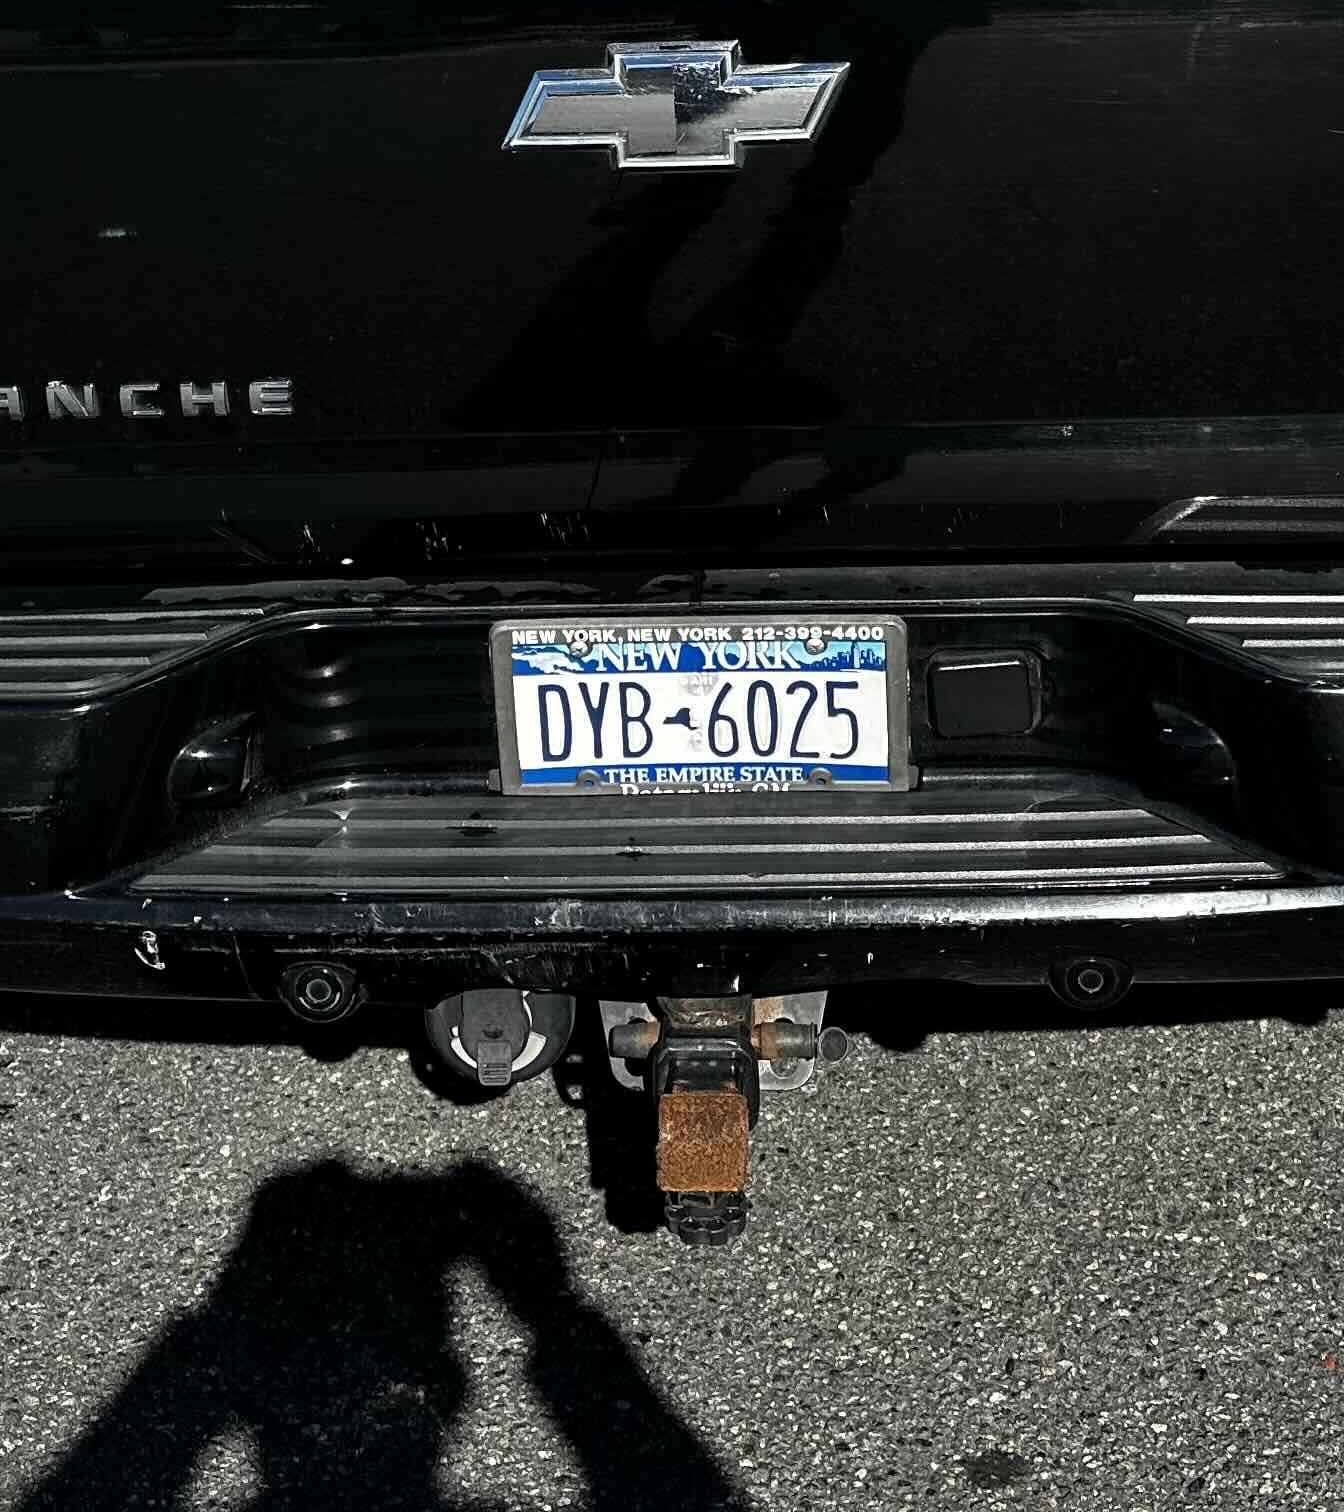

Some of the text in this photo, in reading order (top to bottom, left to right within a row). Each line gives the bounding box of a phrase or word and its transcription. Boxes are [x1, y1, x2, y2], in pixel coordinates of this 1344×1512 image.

[511, 626, 884, 644] NEW YORK, NEW YORK 212-399-4400
[594, 640, 801, 672] NEW YORK
[537, 679, 860, 762] DYB 6025
[603, 766, 804, 784] THE EMPIRE STATE
